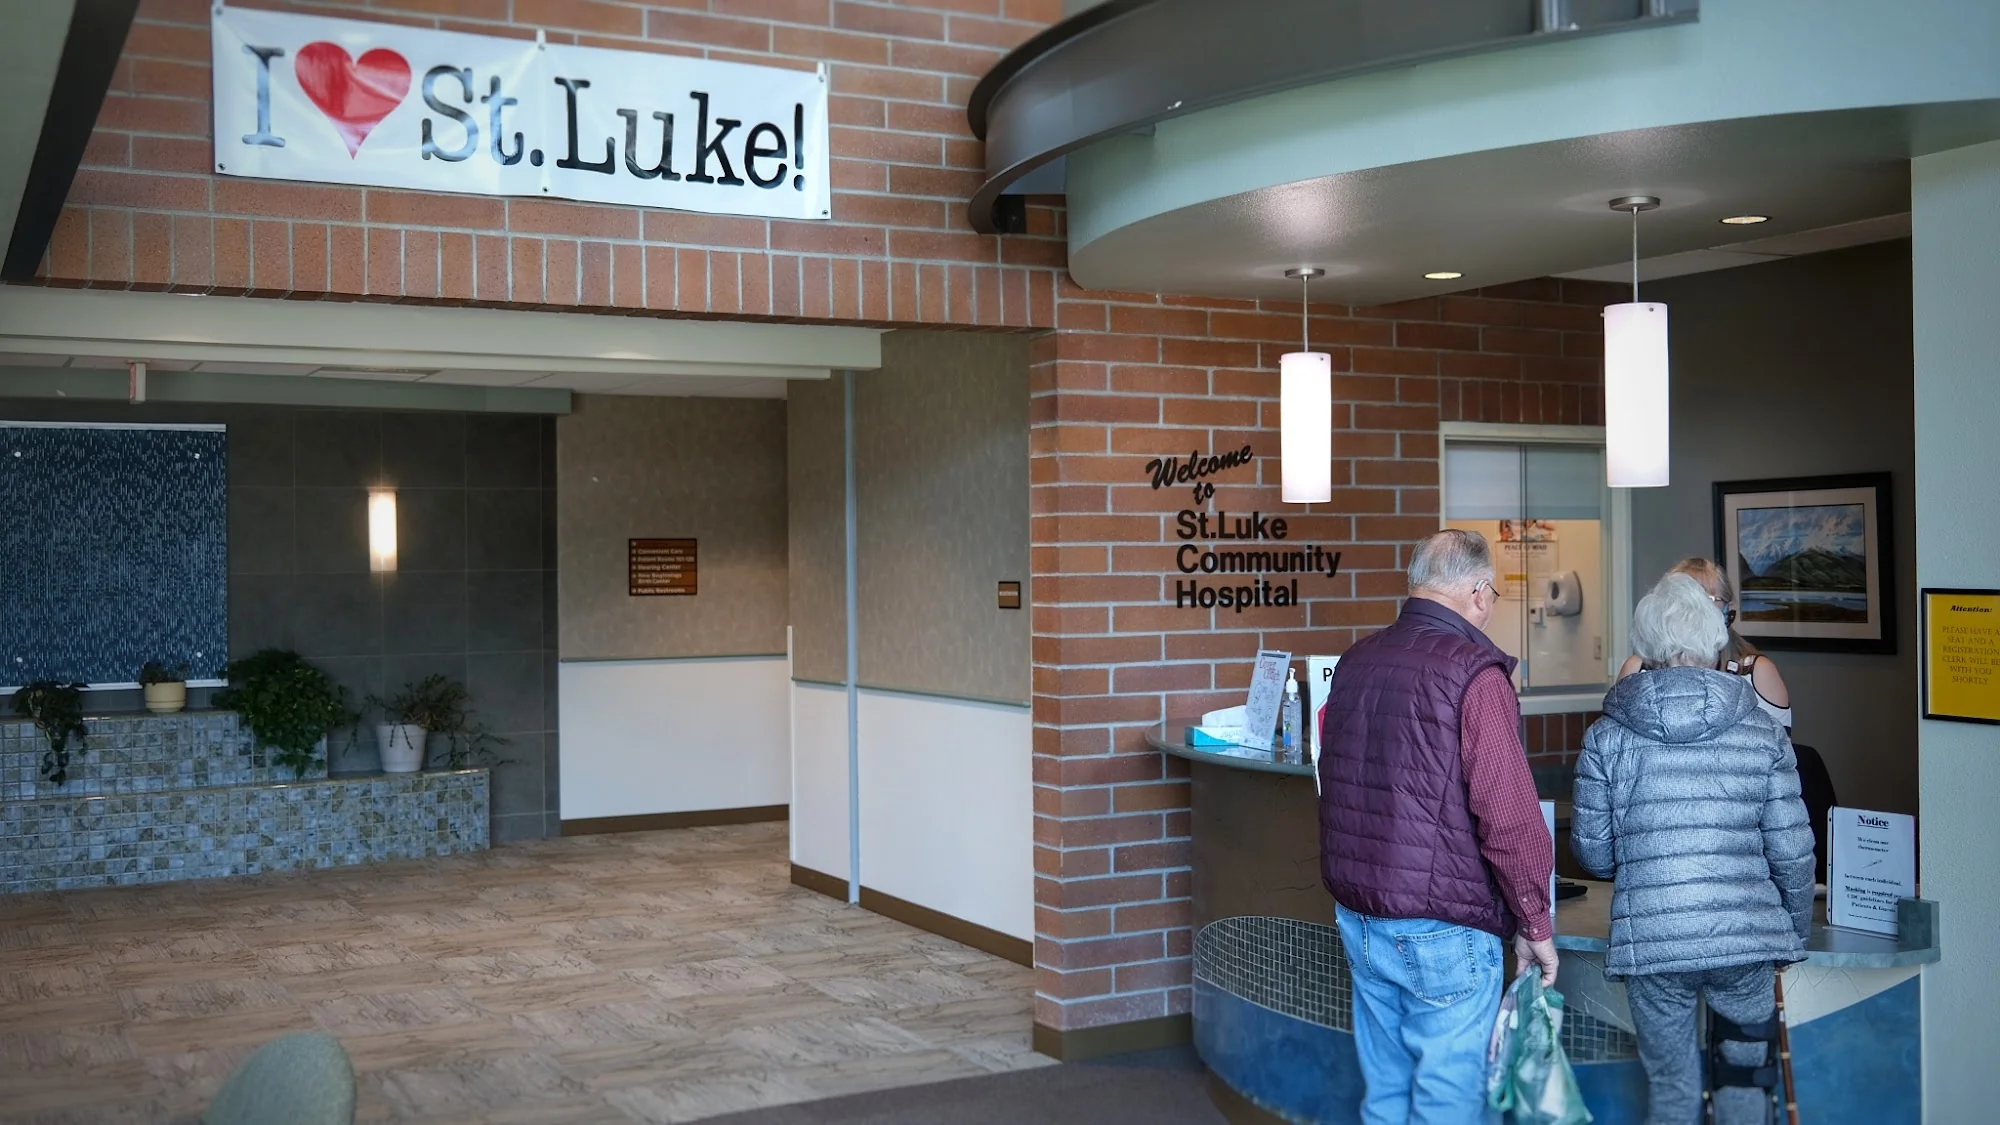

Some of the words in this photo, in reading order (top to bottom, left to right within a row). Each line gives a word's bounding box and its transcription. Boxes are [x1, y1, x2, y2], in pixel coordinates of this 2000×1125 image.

[241, 44, 285, 148] I
[1145, 445, 1253, 490] Welcome
[1193, 481, 1215, 505] to
[1176, 544, 1341, 578] Community
[1176, 579, 1298, 614] Hospital
[1950, 605, 1992, 613] Attention:
[1942, 626, 1967, 635] PLEASE
[1970, 627, 1992, 636] HAVE
[1947, 636, 1965, 644] SEAT
[1969, 637, 1987, 645] AND
[1989, 638, 1995, 646] A
[1942, 646, 2000, 656] REGISTRATION
[1942, 655, 1966, 664] CLERK
[1969, 657, 1989, 665] WILL
[1991, 658, 2000, 666] BE
[1950, 665, 1972, 674] WITH
[1974, 667, 1992, 675] YOU
[1952, 675, 1988, 685] SHORTLY
[1857, 815, 1889, 828] Notice
